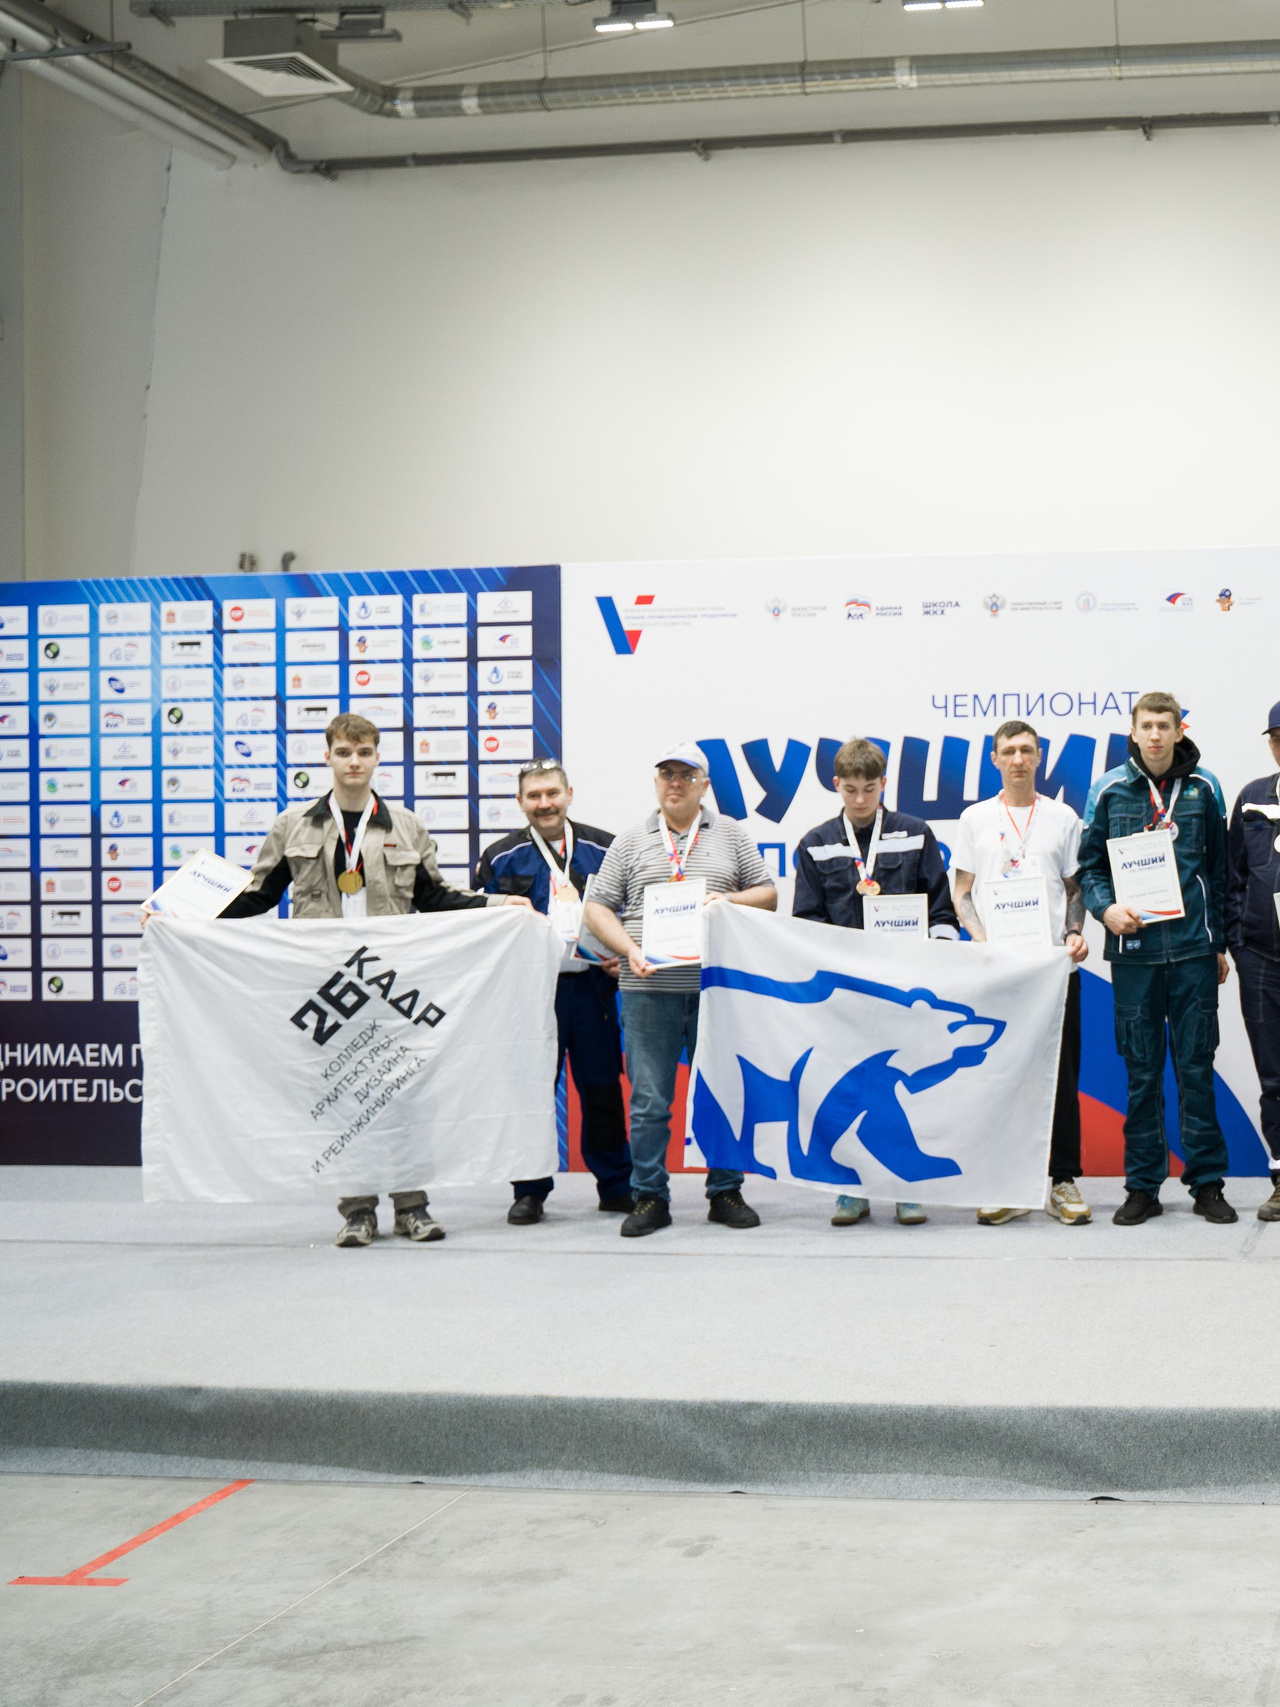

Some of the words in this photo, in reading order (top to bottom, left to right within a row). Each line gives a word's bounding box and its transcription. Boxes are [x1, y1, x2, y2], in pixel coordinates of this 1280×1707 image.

[922, 601, 960, 609] ШКОЛА
[932, 691, 1139, 718] ЧЕМПИОНАТ
[695, 733, 1132, 824] ЛУЧШИ
[1121, 853, 1166, 870] ЛУЧШИЙ
[653, 901, 697, 915] ЛУЧШИЙ
[874, 916, 919, 928] ЛУЧШИЙ
[994, 896, 1039, 911] ЛУЧШИЙ
[289, 970, 371, 1046] 26
[343, 945, 447, 1028] КАДР
[0, 1043, 123, 1072] НИМАЕМ
[321, 1018, 383, 1082] КОЛЛЕДЖ
[310, 1034, 398, 1122] АРХИТЕКТУРЫ,
[353, 1045, 412, 1104] ДИЗАЙНА
[311, 1161, 325, 1173] И
[322, 1056, 427, 1164] РЕИНЖИНИРИНГА
